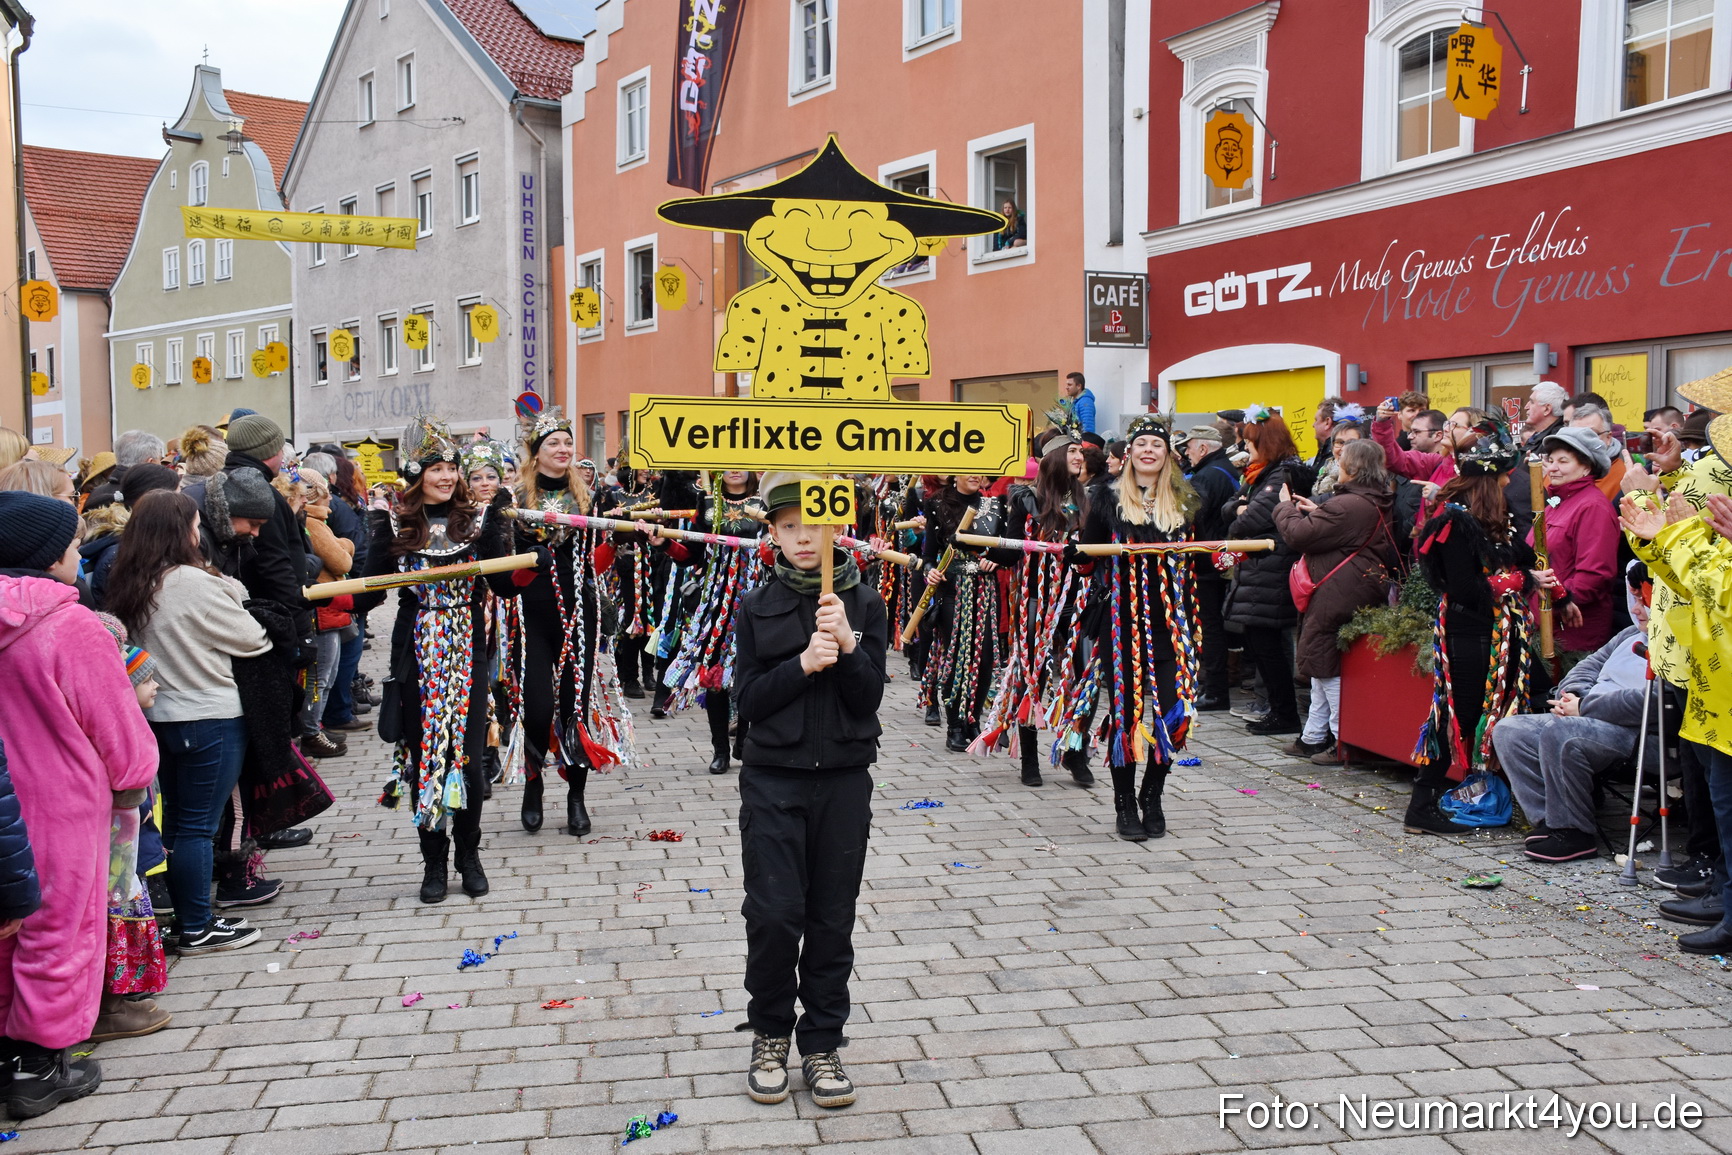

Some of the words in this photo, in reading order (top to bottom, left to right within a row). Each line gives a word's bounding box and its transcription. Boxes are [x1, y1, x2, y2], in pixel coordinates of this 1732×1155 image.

[522, 174, 535, 260] UHREN
[1329, 239, 1398, 298] Mode
[1401, 249, 1475, 300] Genuss
[1486, 205, 1589, 270] Erlebnis
[1093, 281, 1140, 307] CAFÉ
[1362, 234, 1485, 331] Mode
[1491, 252, 1635, 338] Genuss
[522, 273, 536, 392] SCHMUCK
[344, 389, 387, 421] OPTIK
[658, 416, 822, 452] Verflixte
[836, 419, 985, 454] Gmixde
[805, 485, 851, 518] 36
